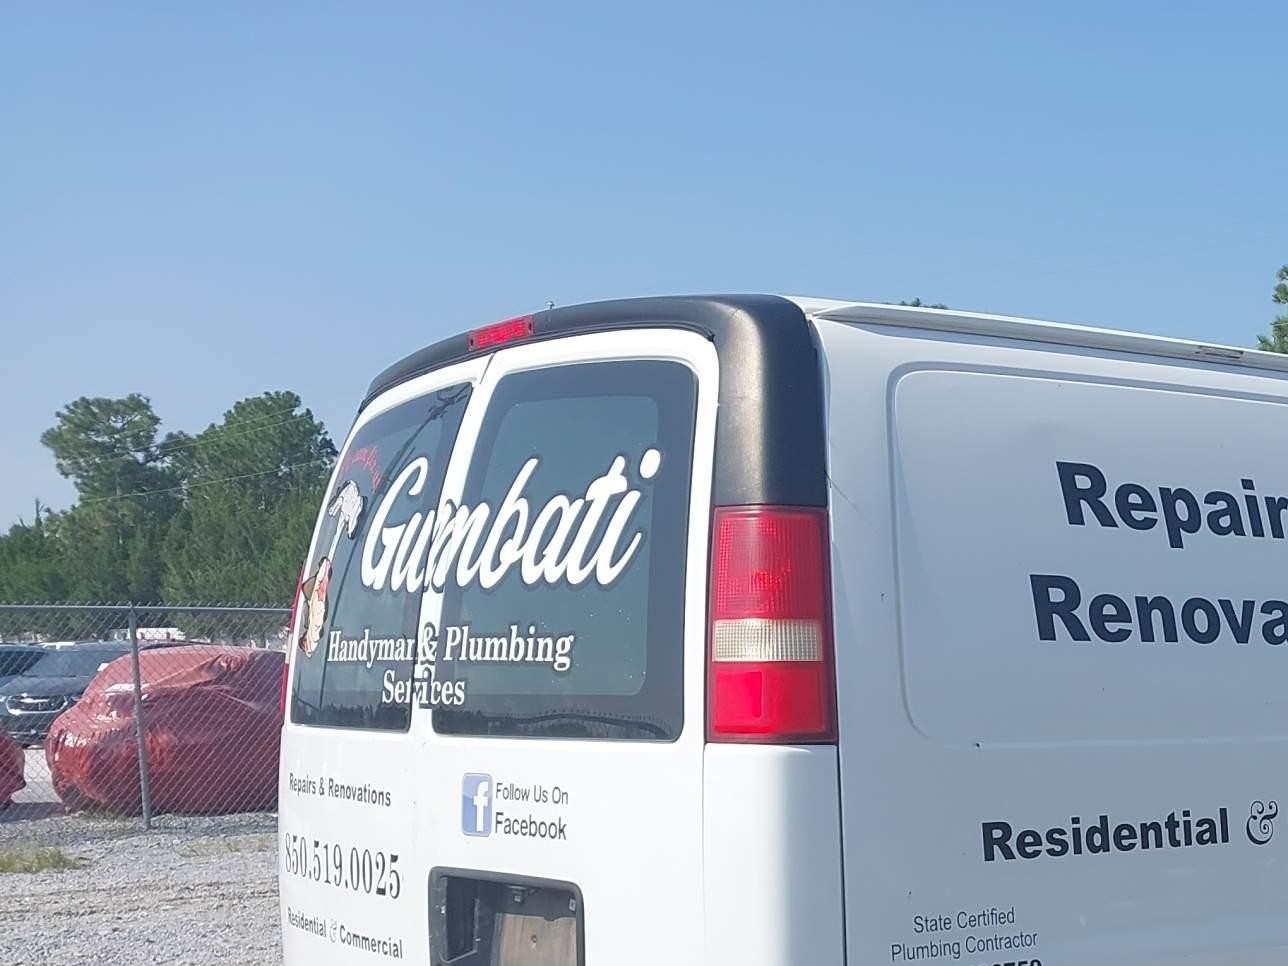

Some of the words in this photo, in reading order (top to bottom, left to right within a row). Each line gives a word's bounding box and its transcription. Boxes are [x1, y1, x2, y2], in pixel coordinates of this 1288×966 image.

[361, 449, 661, 592] Gumbati
[443, 626, 574, 670] Plumbing
[289, 772, 316, 796] Repairs
[319, 777, 325, 796] &
[328, 778, 392, 807] Renovations
[495, 782, 530, 801] Follow
[533, 785, 548, 803] Us
[551, 786, 568, 805] On
[495, 811, 567, 840] Facebook
[982, 808, 1230, 861] Residential
[1246, 800, 1279, 845] &
[285, 832, 401, 899] 850.519.0025
[287, 906, 328, 938] Residential
[340, 924, 403, 959] Commercial
[913, 914, 952, 934] State
[957, 906, 1015, 930] Certified
[891, 940, 961, 961] Plumbing
[965, 931, 1038, 953] Contractor
